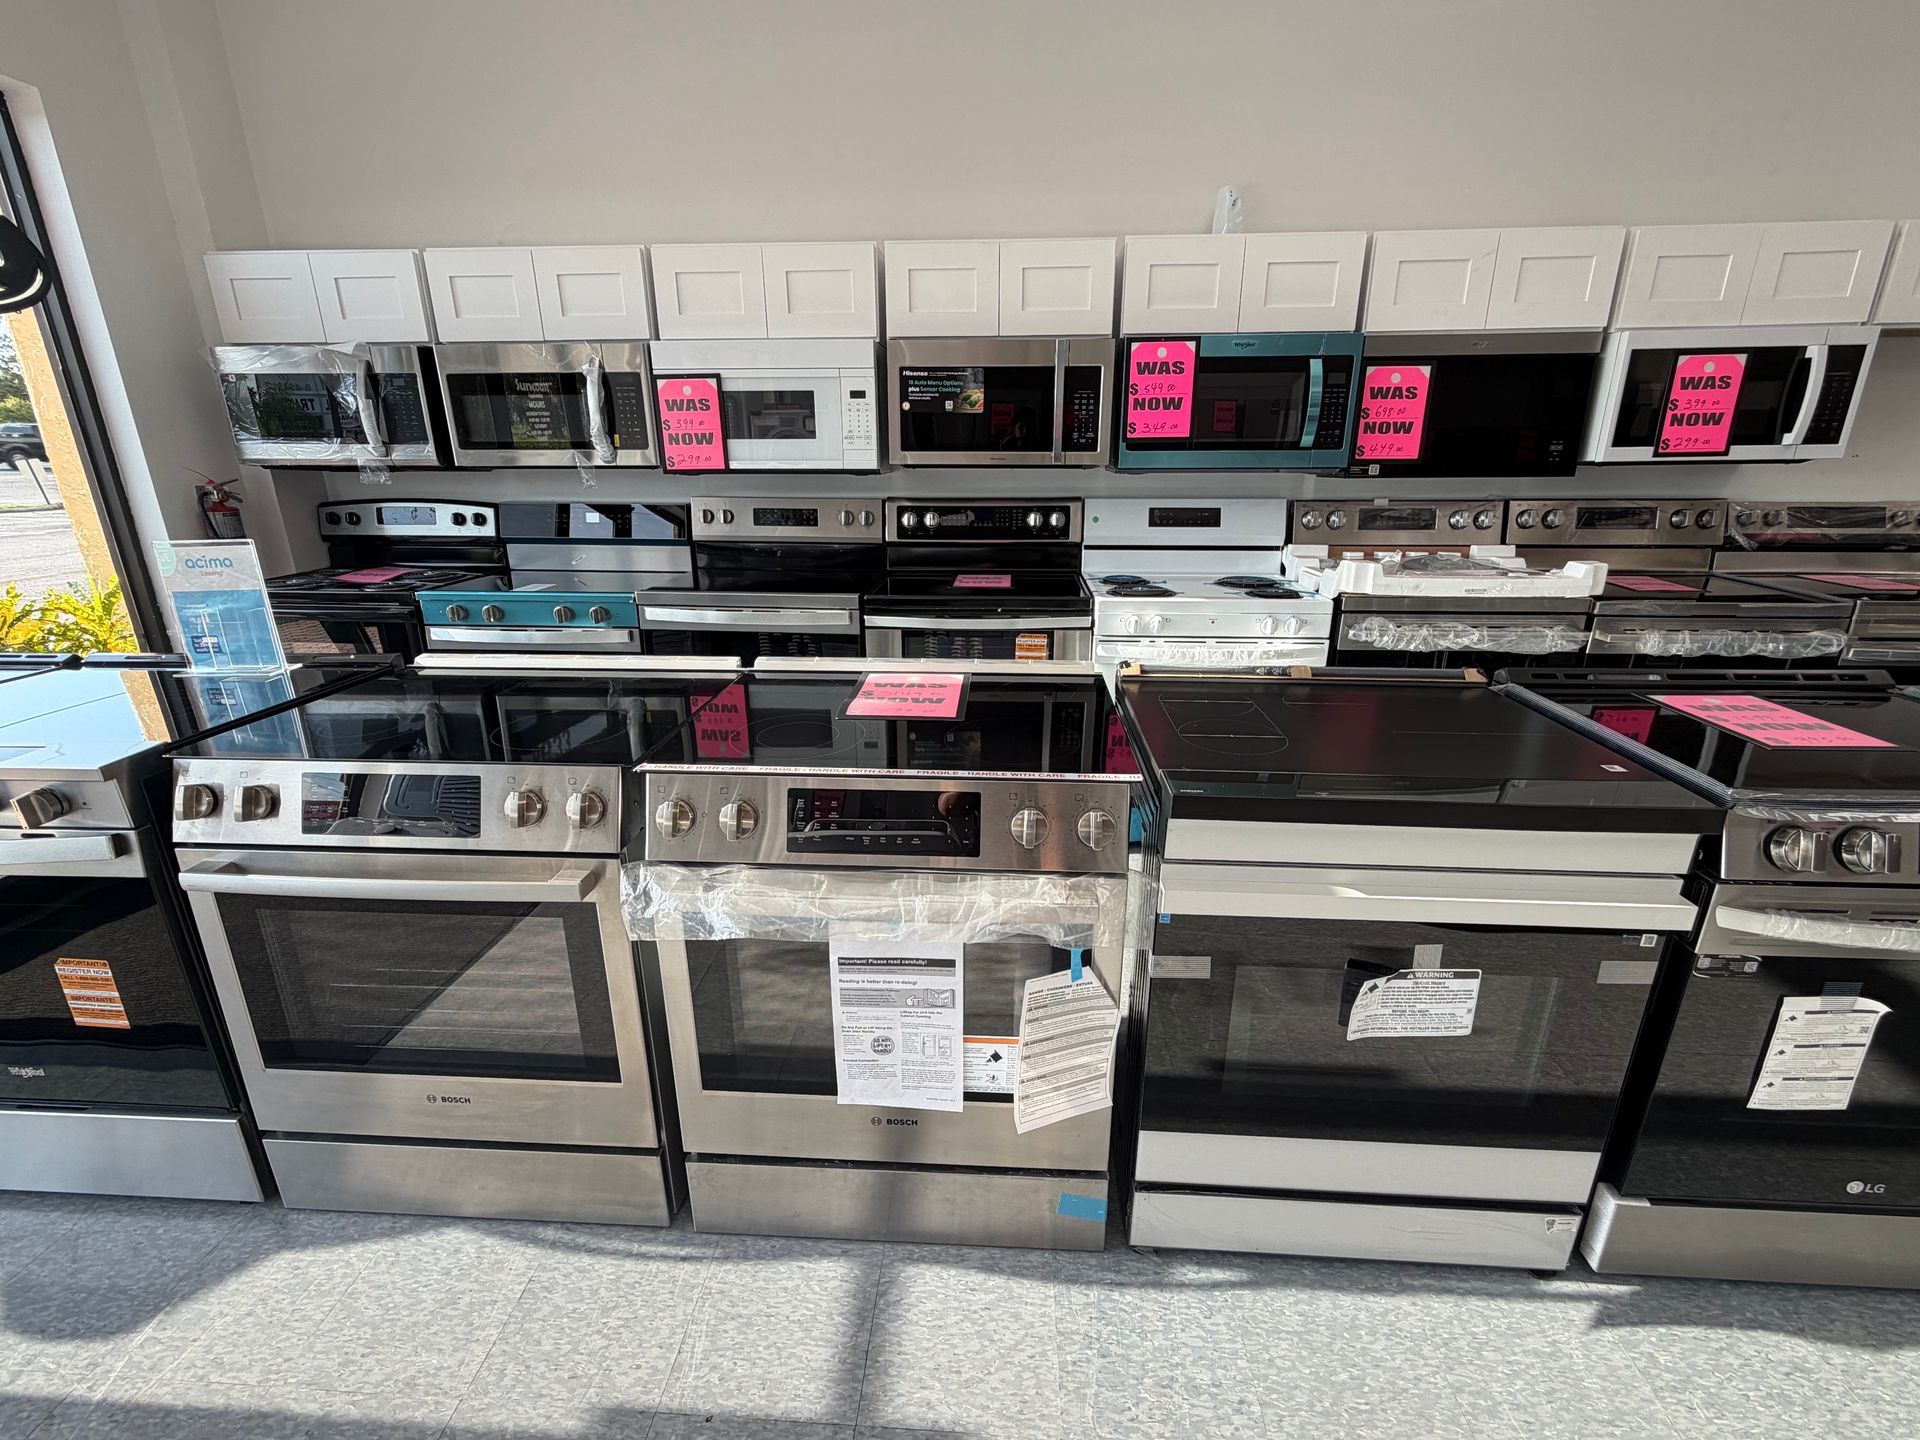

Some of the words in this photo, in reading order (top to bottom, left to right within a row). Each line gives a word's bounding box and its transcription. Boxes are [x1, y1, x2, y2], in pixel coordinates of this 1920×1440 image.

[1136, 361, 1185, 375] WAS
[1130, 383, 1138, 396] $
[1680, 376, 1732, 390] WAS
[1370, 386, 1418, 400] WAS
[664, 398, 711, 412] WAS
[1133, 397, 1184, 410] NOW
[1669, 398, 1679, 411] $
[1361, 407, 1370, 420] $
[1669, 412, 1725, 426] NOW
[663, 419, 671, 431] $
[1128, 422, 1136, 434] $
[1363, 422, 1414, 434] NOW
[668, 432, 714, 445] NOW
[1661, 438, 1670, 450] $
[1356, 445, 1365, 457] $
[667, 455, 675, 467] $
[185, 555, 234, 569] acima
[441, 1096, 471, 1104] BOSCH
[1865, 1184, 1886, 1194] LG
